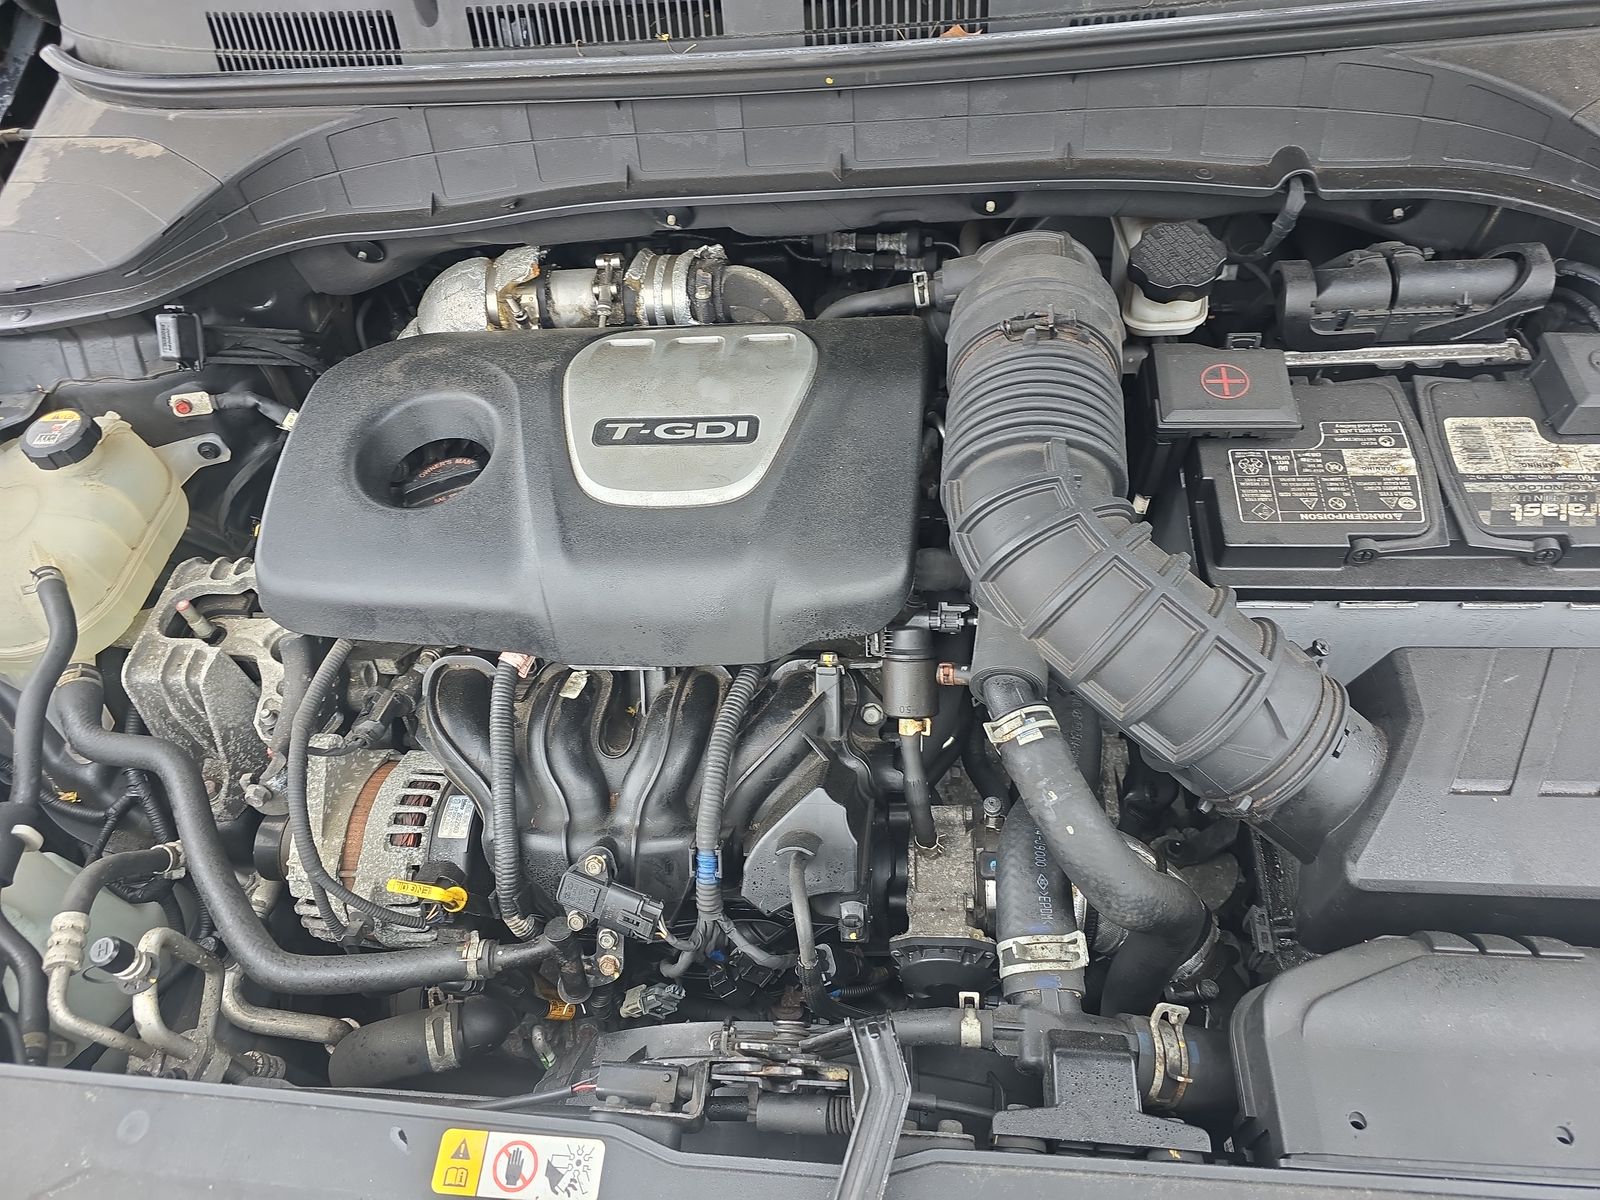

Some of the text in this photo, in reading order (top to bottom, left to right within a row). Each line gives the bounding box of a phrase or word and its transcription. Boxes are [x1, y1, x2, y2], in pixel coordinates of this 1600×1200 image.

[605, 420, 749, 440] T-GDI
[1510, 502, 1600, 521] ralast
[97, 941, 109, 957] H
